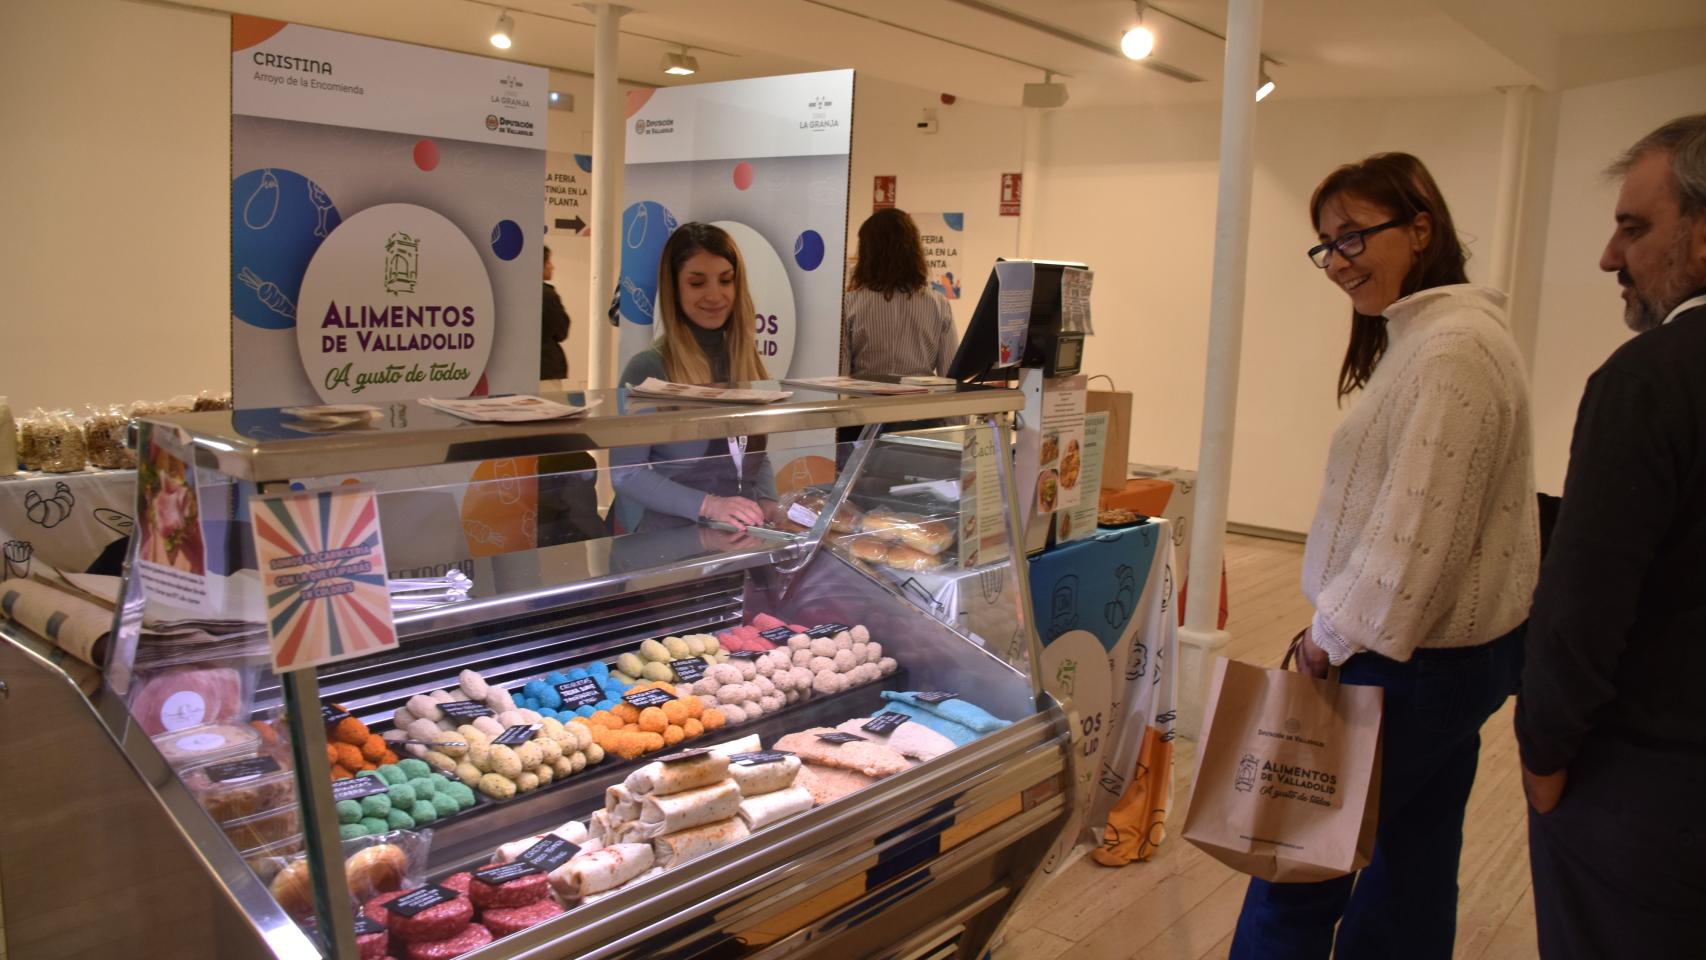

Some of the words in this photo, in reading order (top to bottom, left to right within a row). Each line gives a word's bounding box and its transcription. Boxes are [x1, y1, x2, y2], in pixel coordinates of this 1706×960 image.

[253, 52, 332, 75] CRISTINA
[254, 71, 284, 85] Arroyo
[286, 76, 298, 86] de
[300, 77, 308, 87] la
[311, 79, 365, 95] Encomienda
[501, 97, 530, 107] GRANJA
[799, 121, 808, 129] LA
[810, 119, 839, 128] GRANJA
[554, 174, 577, 184] FERIA
[545, 185, 567, 194] TINÚA
[567, 187, 578, 196] EN
[580, 189, 589, 197] LA
[549, 197, 579, 207] PLANTA
[935, 248, 946, 256] EN
[947, 249, 958, 257] LA
[321, 300, 475, 329] ALIMENTOS
[322, 334, 347, 353] DE
[356, 330, 475, 353] VALLADOLID
[325, 362, 354, 391] A
[351, 364, 405, 394] gusto
[405, 363, 427, 383] de
[430, 362, 471, 382] todos
[271, 554, 304, 570] SOMOS
[304, 552, 317, 564] LA
[318, 544, 372, 562] CARNICERÍA
[275, 574, 295, 587] CON
[295, 572, 309, 584] LA
[310, 570, 328, 583] QUE
[328, 560, 372, 578] FLIPARÁS
[302, 588, 314, 600] EN
[314, 582, 354, 599] COLORES
[1260, 772, 1273, 782] DE
[1278, 774, 1336, 794] VALLADOLID
[1262, 760, 1337, 785] ALIMENTOS
[1308, 795, 1331, 807] todos
